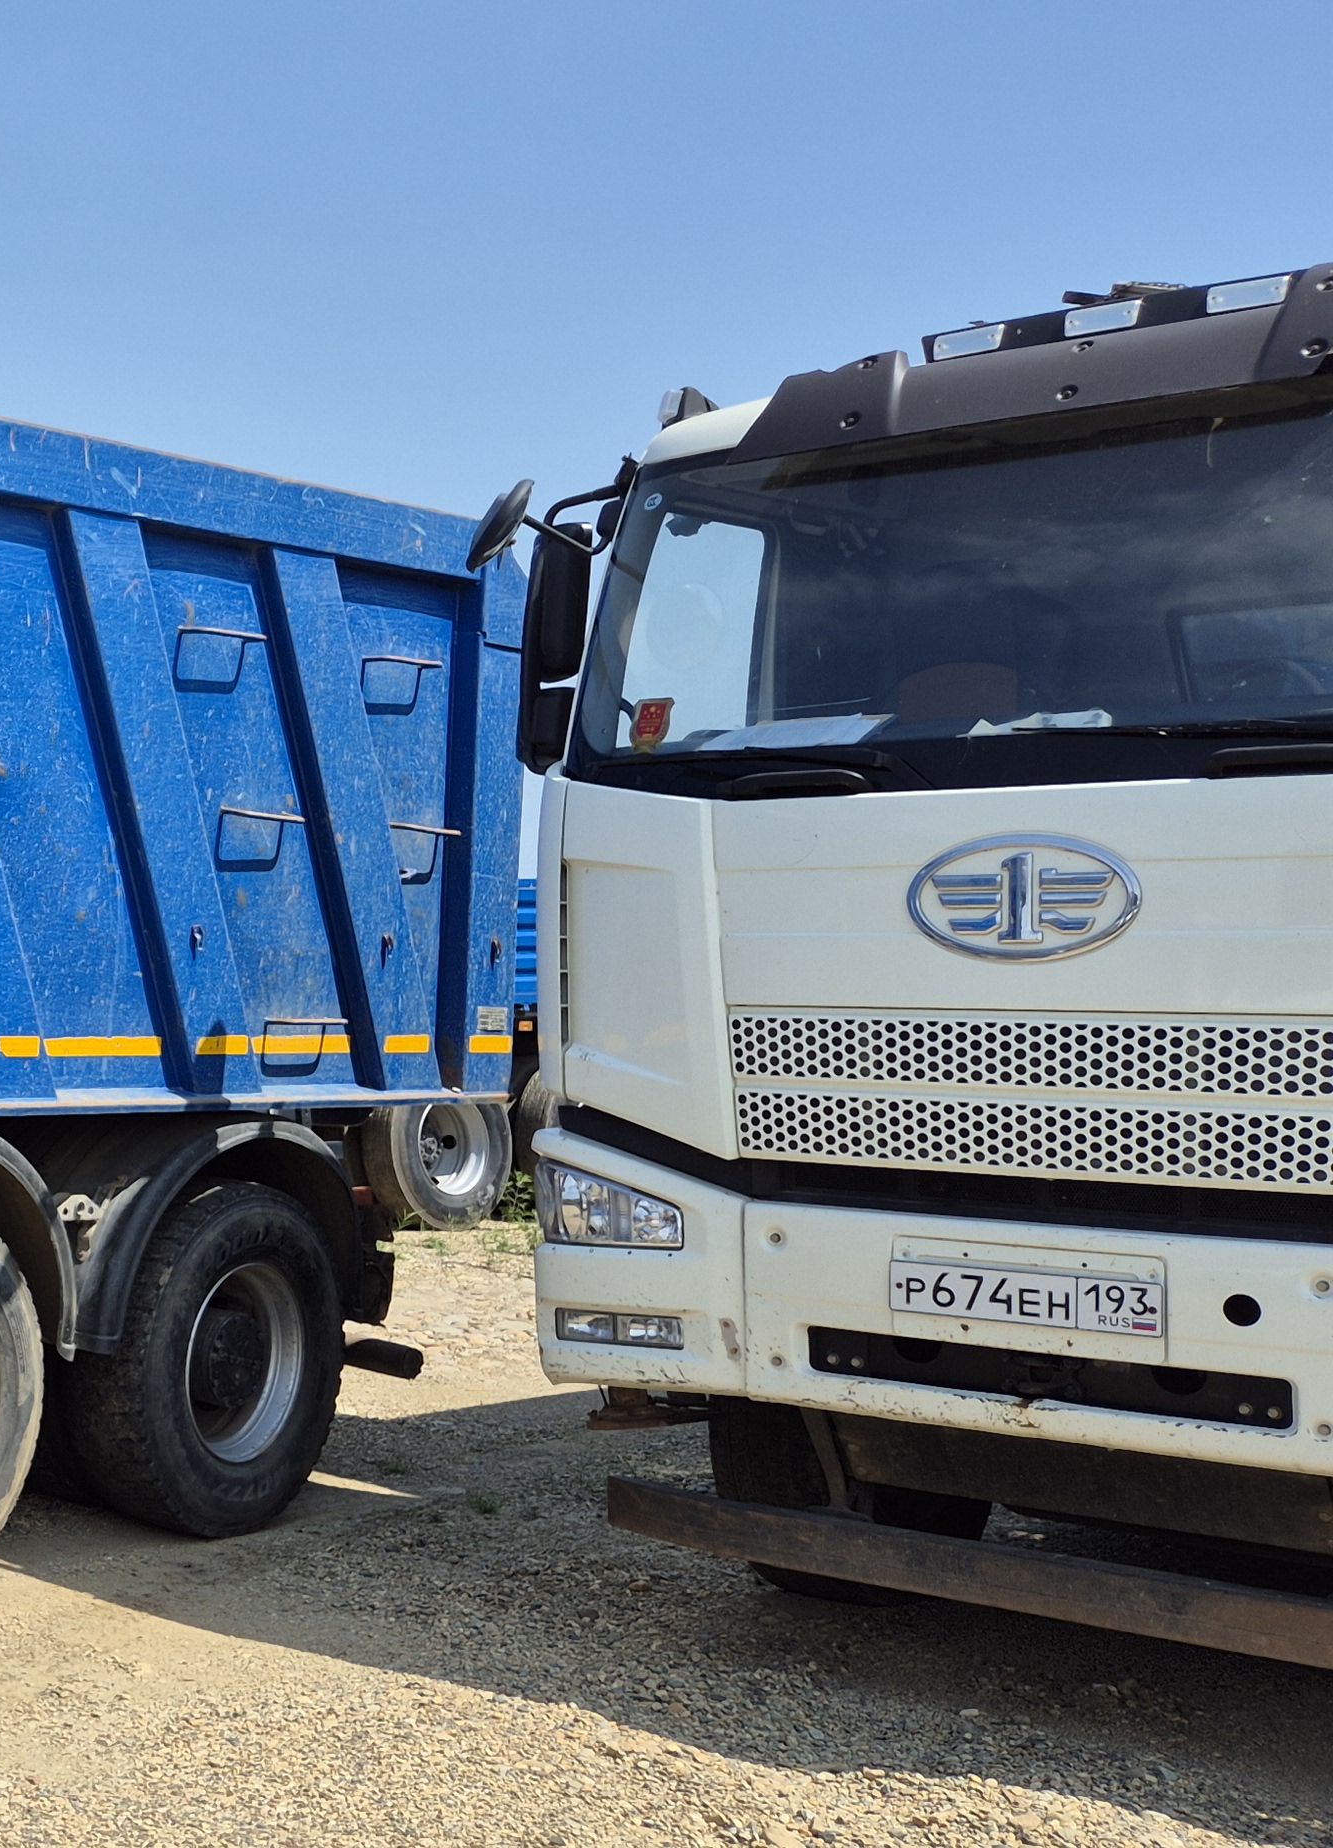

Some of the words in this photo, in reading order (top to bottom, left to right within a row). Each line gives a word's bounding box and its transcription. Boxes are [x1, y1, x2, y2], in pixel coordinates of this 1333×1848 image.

[905, 1272, 1070, 1321] Р674ЕН
[1084, 1284, 1149, 1316] 193
[1097, 1314, 1132, 1329] RUS
